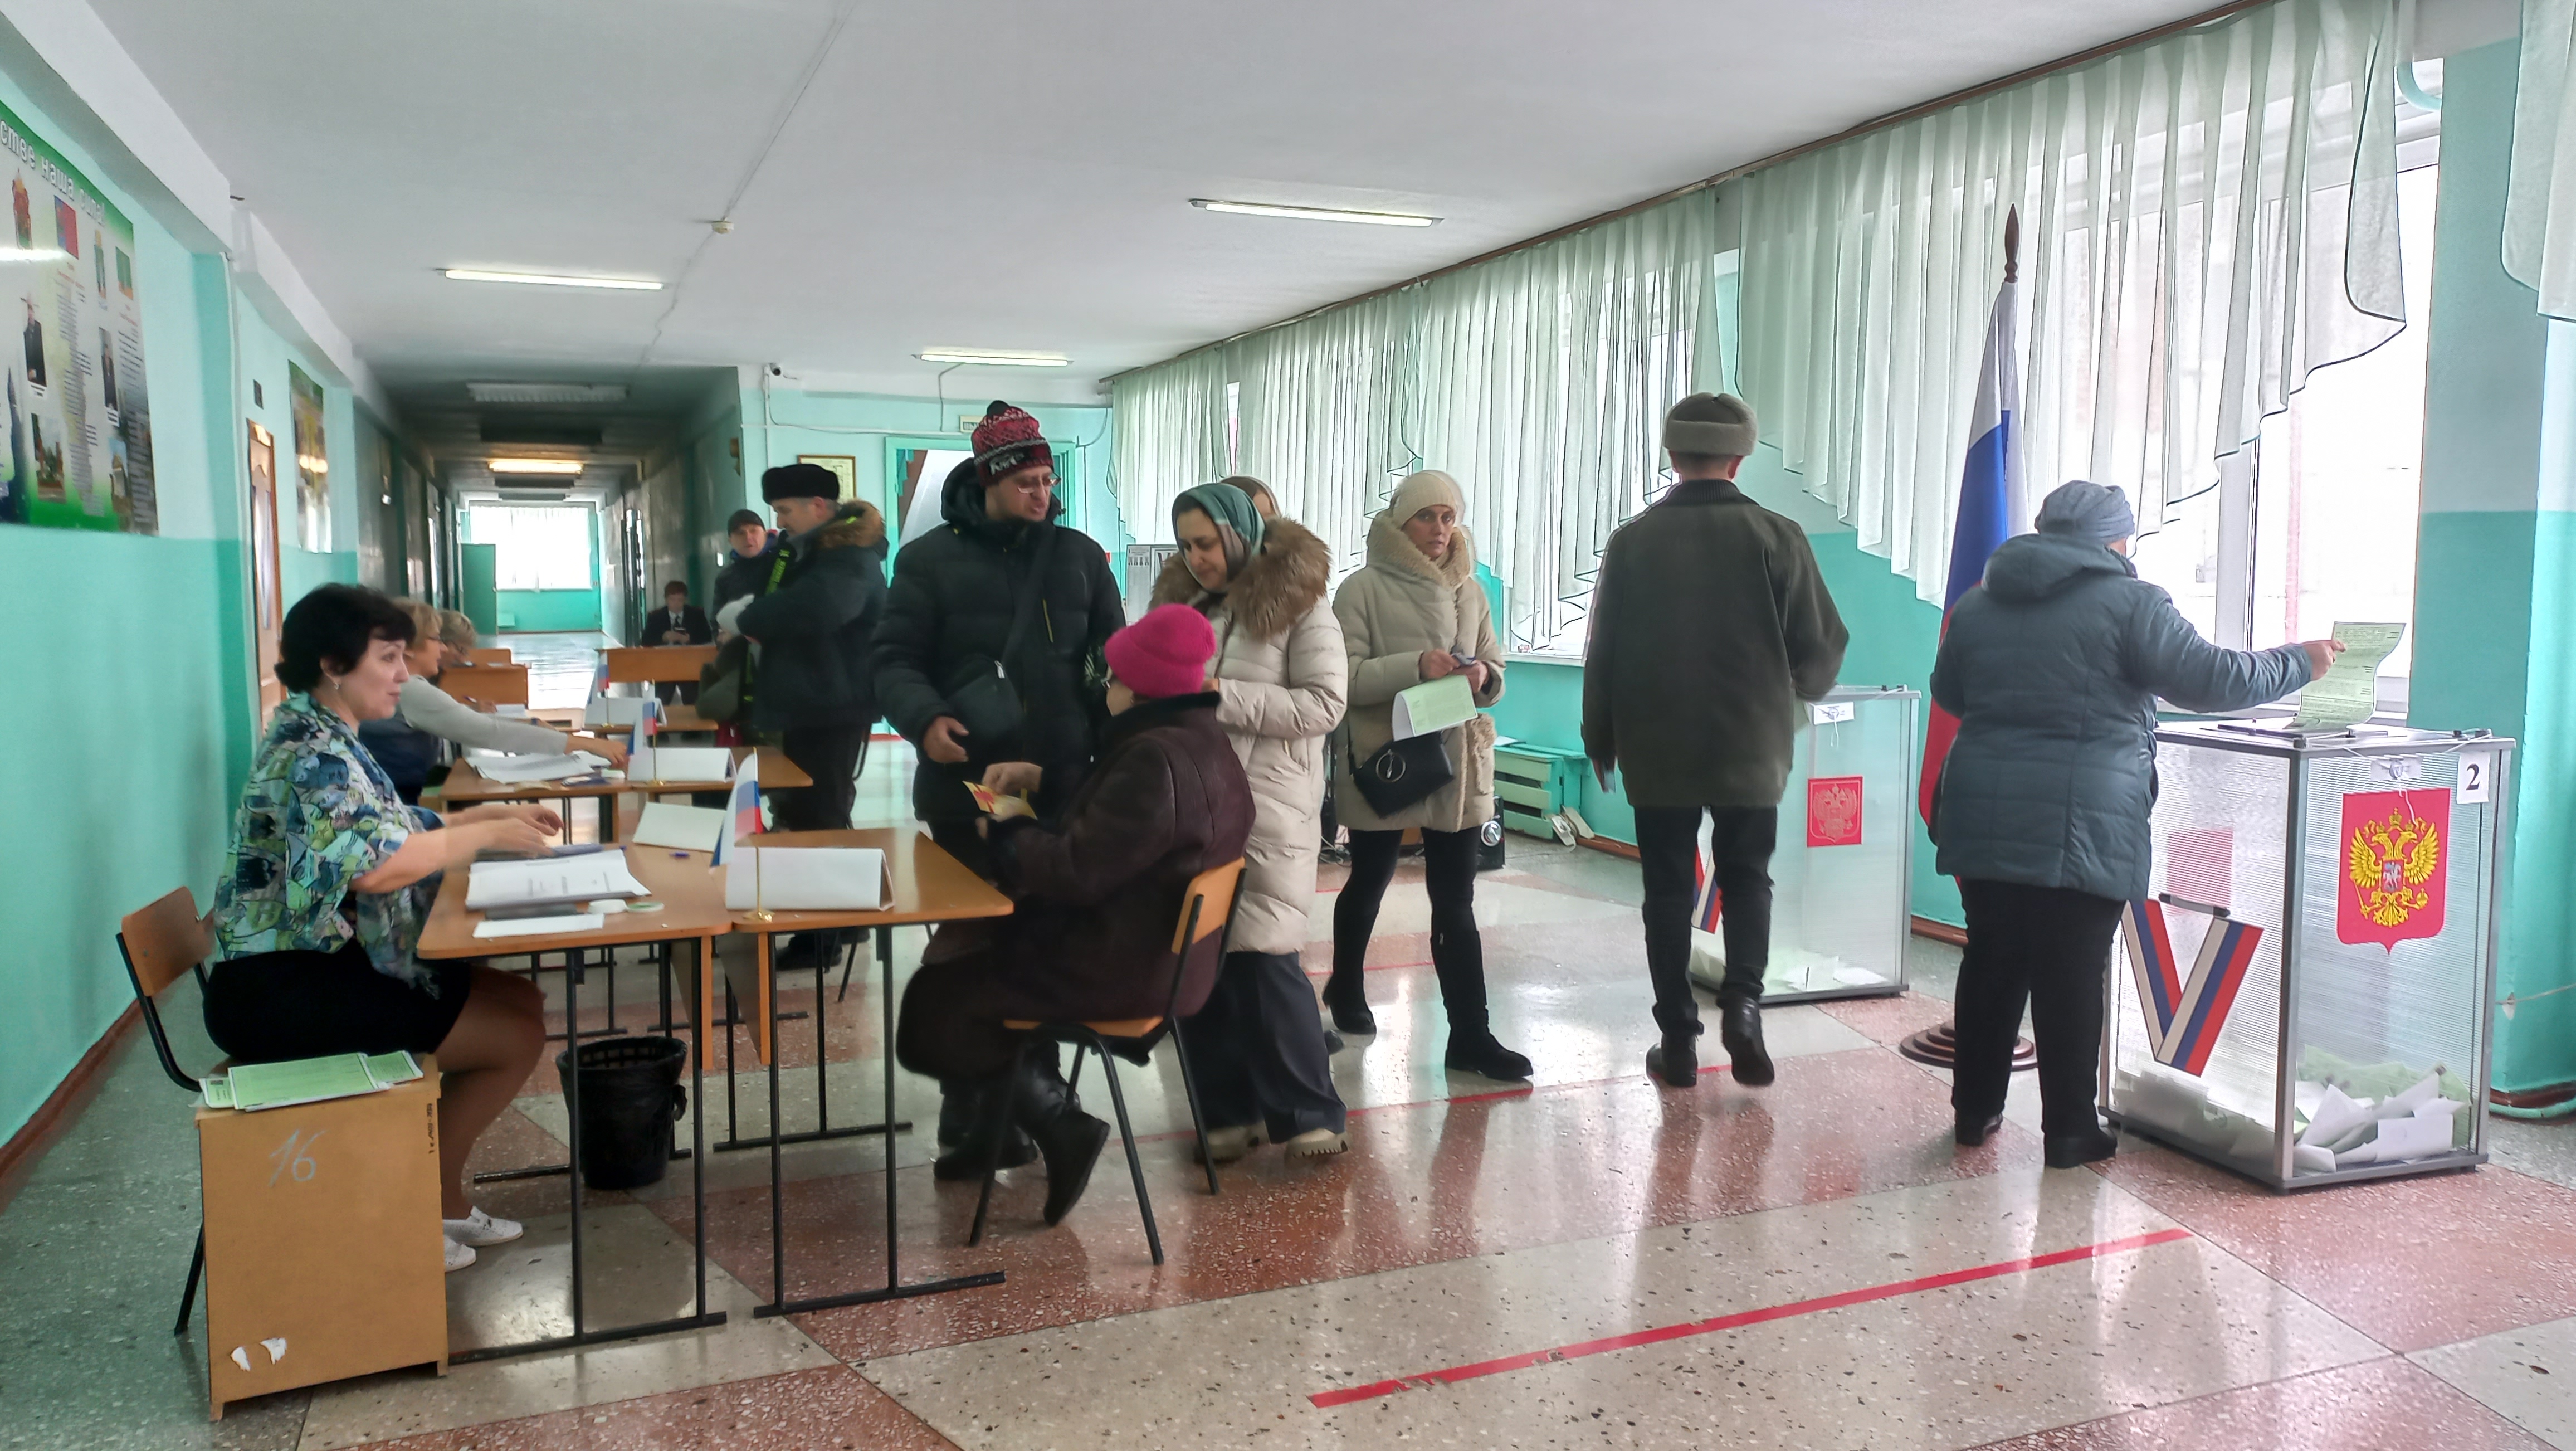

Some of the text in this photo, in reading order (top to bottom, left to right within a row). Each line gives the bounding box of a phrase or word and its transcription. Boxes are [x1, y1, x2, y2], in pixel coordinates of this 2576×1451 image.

[40, 155, 75, 202] наша
[2466, 763, 2480, 790] 2
[269, 1129, 326, 1187] 16
